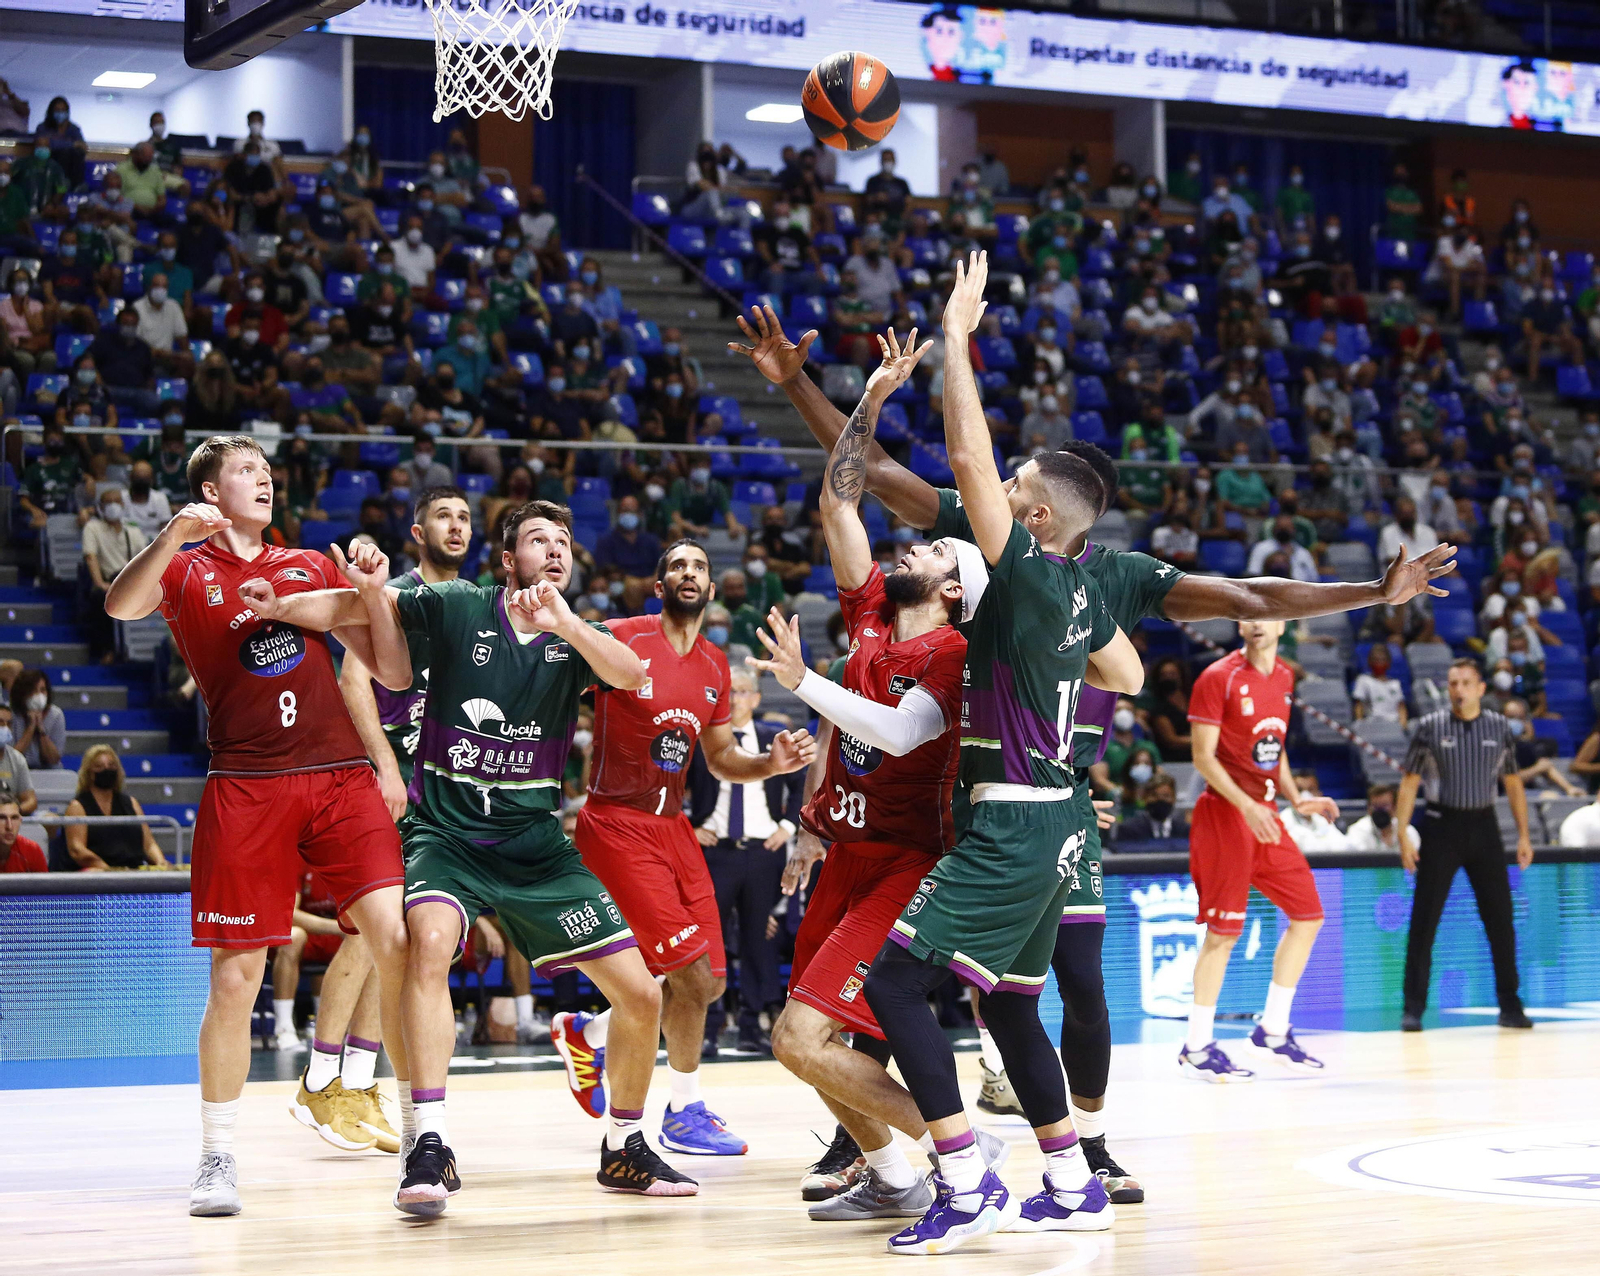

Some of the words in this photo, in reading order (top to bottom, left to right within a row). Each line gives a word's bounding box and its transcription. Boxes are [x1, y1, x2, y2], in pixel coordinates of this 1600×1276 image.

[634, 2, 667, 27] de
[676, 10, 805, 38] seguridad
[1030, 37, 1136, 66] Respetar
[1145, 47, 1252, 74] distancia
[1260, 56, 1288, 77] de
[1298, 66, 1409, 89] seguridad
[250, 631, 294, 654] Estrella
[254, 642, 298, 666] Galicia
[278, 690, 298, 728] 8
[484, 749, 534, 765] MÁAGA
[476, 786, 491, 816] 7
[654, 786, 667, 816] 1
[829, 784, 867, 829] 30
[557, 908, 574, 921] sabor
[563, 916, 602, 940] laga
[565, 900, 597, 928] má
